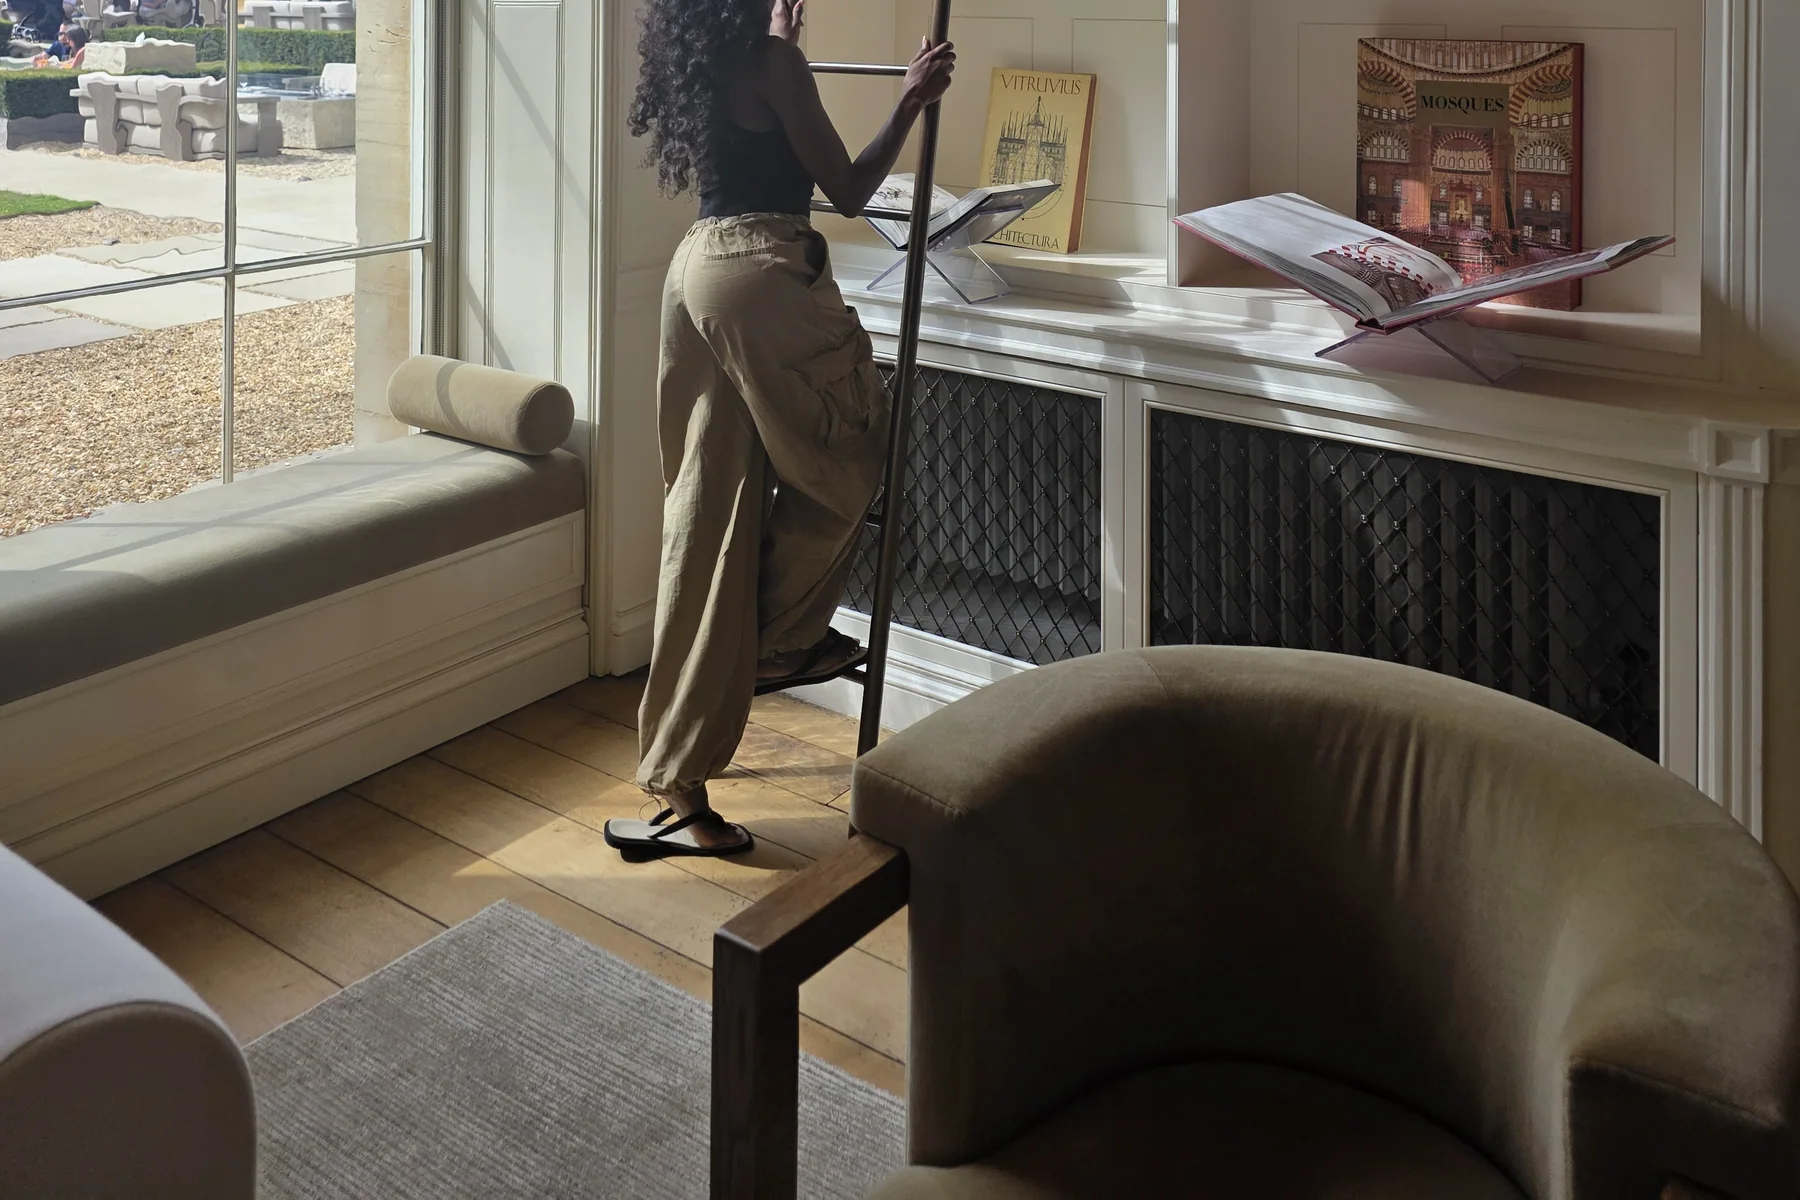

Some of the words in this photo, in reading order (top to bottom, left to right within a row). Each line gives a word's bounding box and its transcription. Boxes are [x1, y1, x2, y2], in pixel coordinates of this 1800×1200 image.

[1001, 74, 1082, 95] VITRUVIUS
[1420, 95, 1505, 115] MOSQUES
[992, 229, 1060, 250] CHITECTURA
